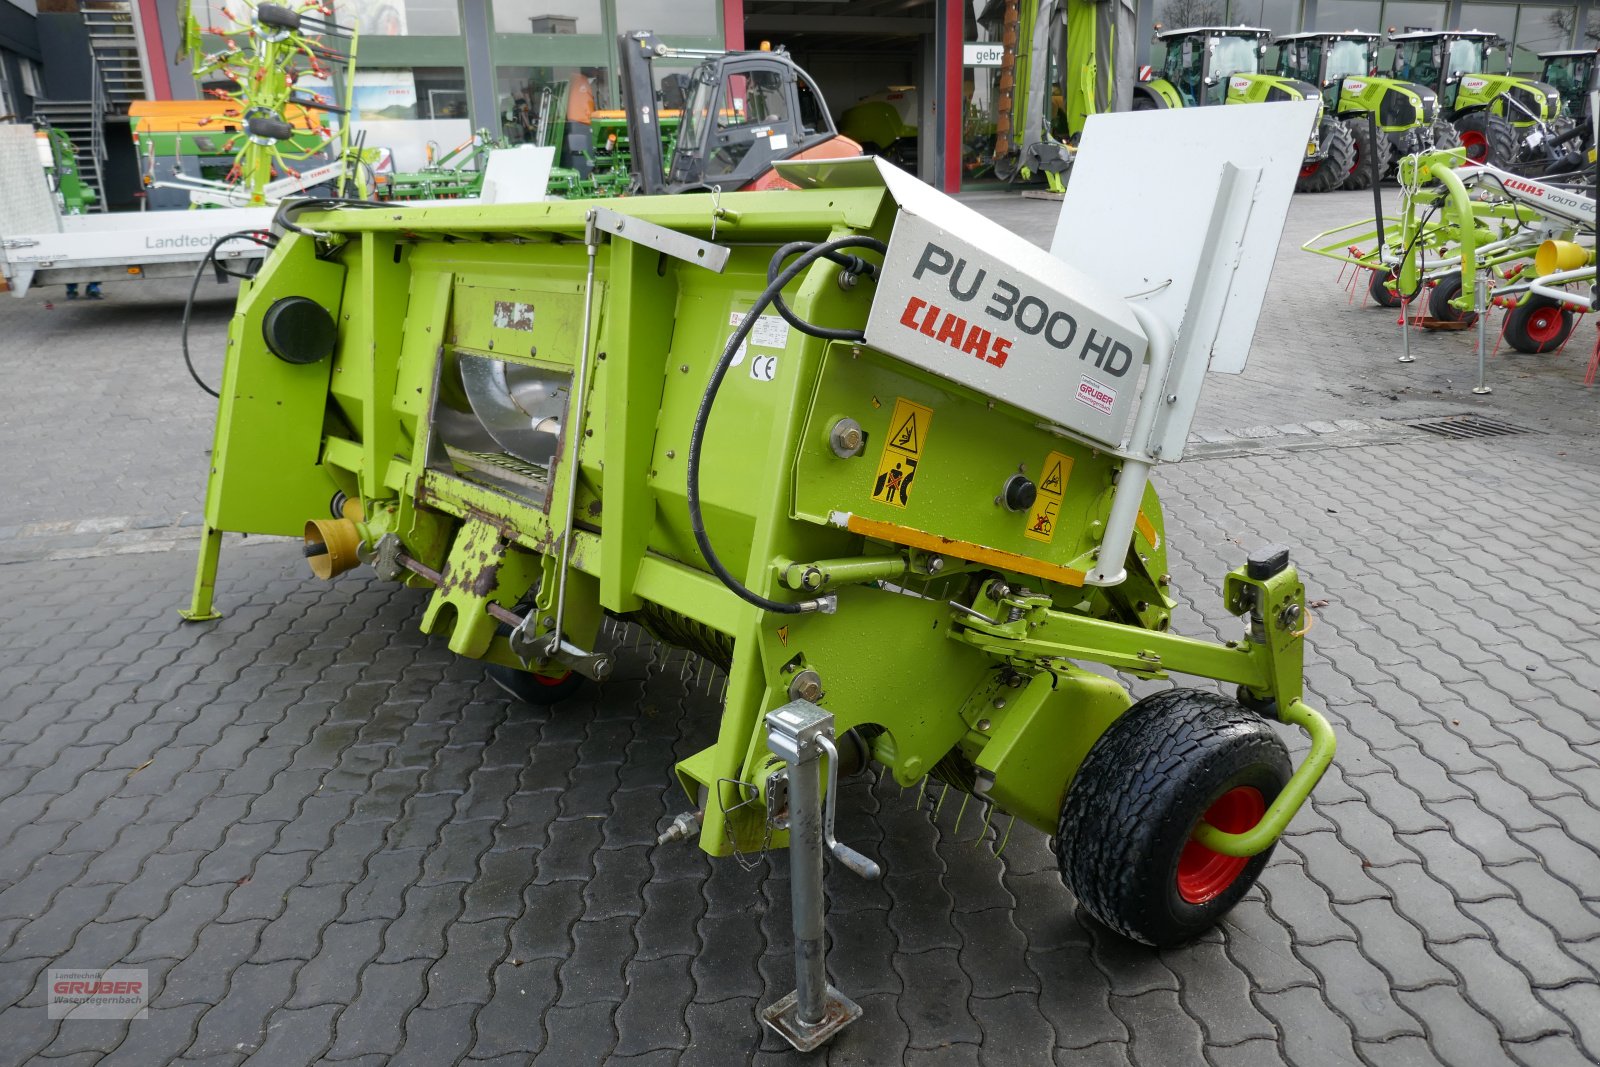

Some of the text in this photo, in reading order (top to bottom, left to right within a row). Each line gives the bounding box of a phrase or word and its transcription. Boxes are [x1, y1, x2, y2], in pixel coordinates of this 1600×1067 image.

[1503, 178, 1545, 196] CLAAS
[1547, 193, 1578, 207] VOLTO
[900, 296, 1013, 369] CLAAS
[912, 242, 1133, 377] PU 300 HD
[1080, 383, 1114, 405] GRUBER
